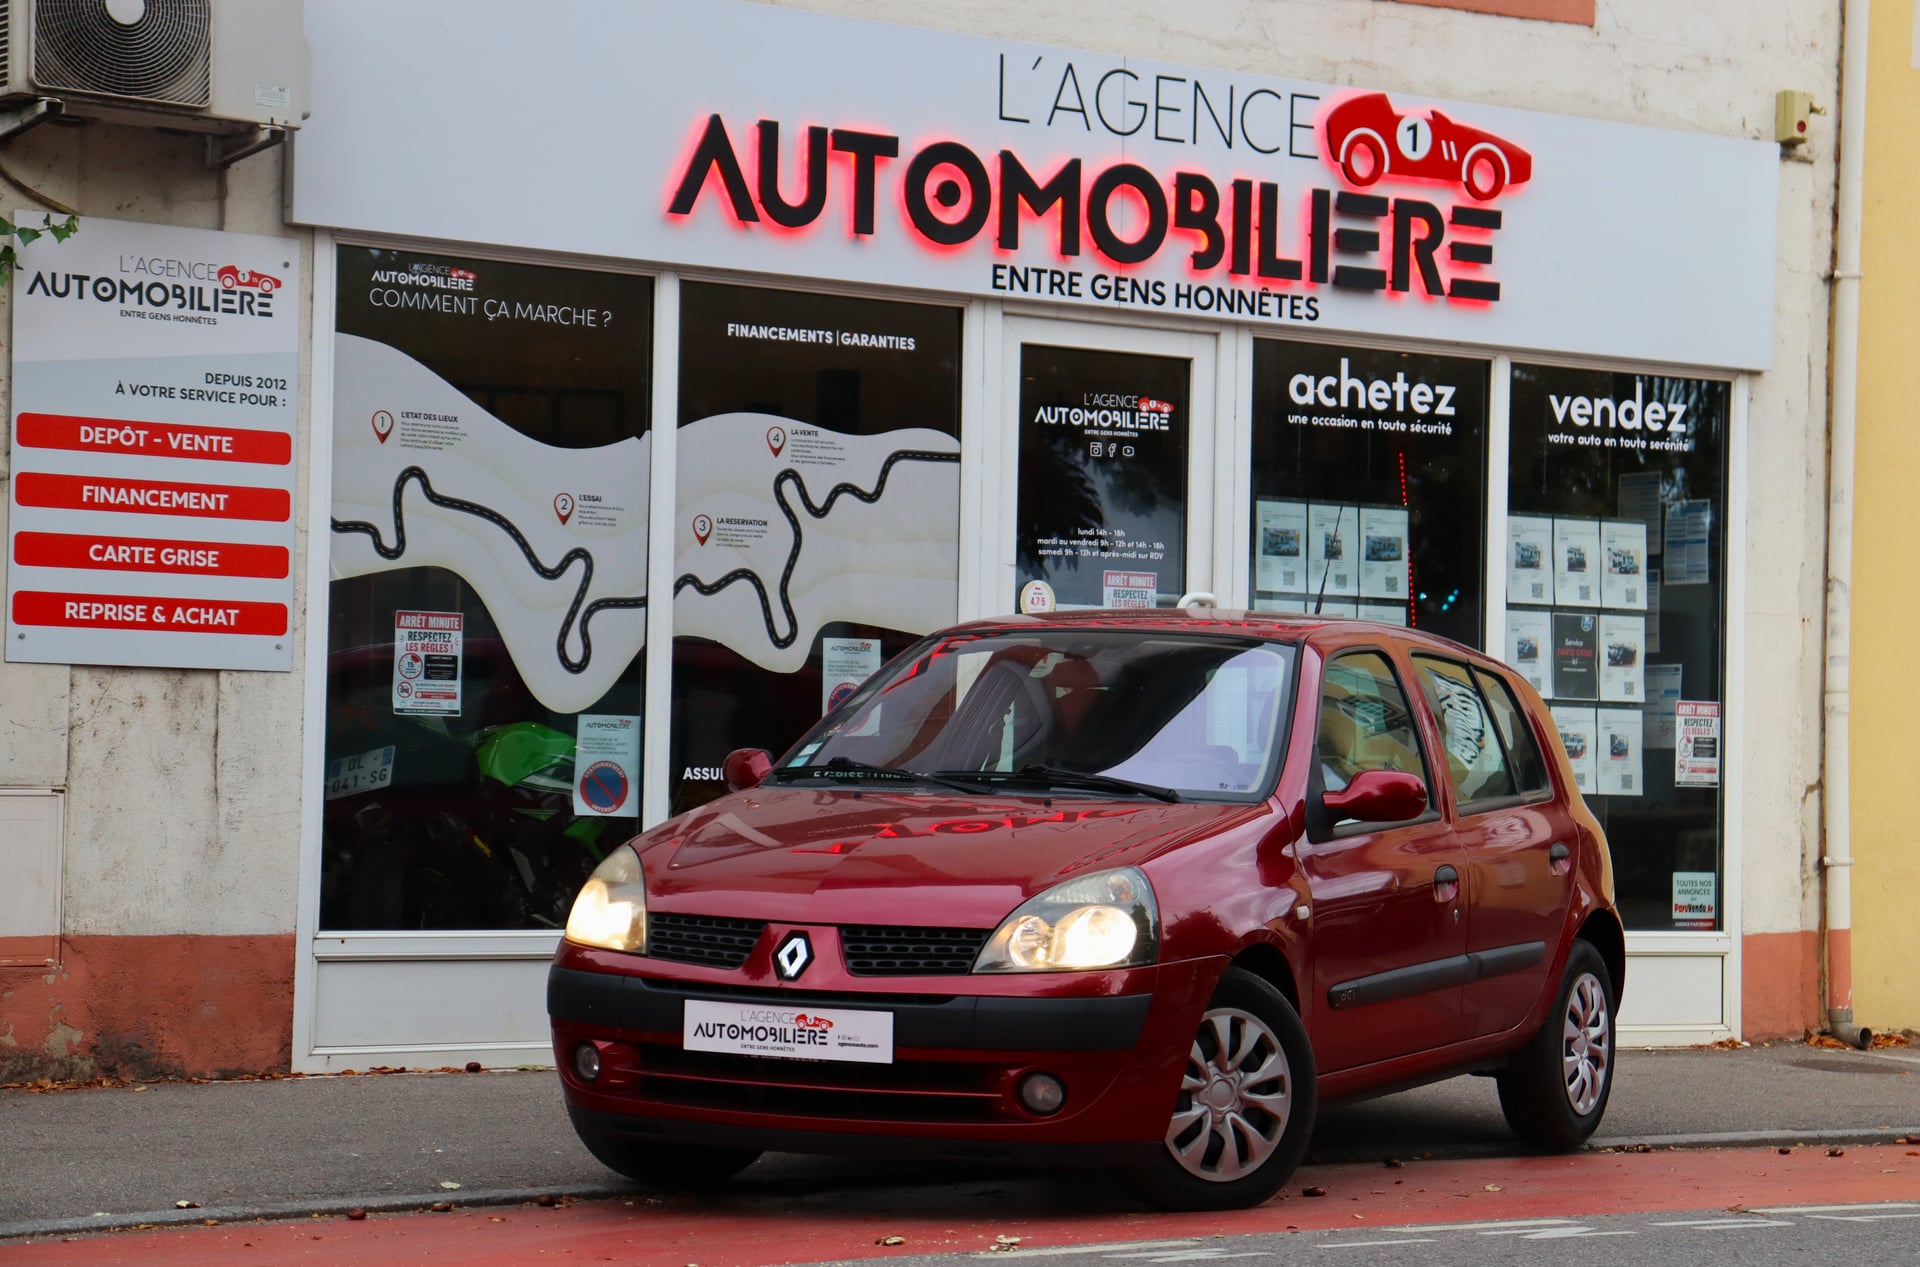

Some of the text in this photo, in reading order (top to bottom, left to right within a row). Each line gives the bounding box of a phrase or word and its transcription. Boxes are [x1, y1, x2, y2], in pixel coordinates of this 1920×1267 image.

[1406, 124, 1421, 151] 1
[991, 262, 1320, 322] ENTRE GENS HONNÊTES
[369, 287, 612, 327] COMMENT ÇA MARCHE ?
[119, 309, 217, 326] ENTRE GENS HONNÊTES
[727, 323, 834, 344] FINANCEMENTS
[840, 332, 916, 351] GARANTIES
[205, 372, 287, 391] DEPUIS 2012
[1288, 357, 1457, 416] achetez
[115, 380, 125, 395] À
[129, 383, 176, 399] VOTRE
[180, 387, 236, 404] SERVICE
[239, 392, 277, 408] POUR
[1549, 381, 1688, 433] vendez
[423, 413, 437, 421] DES
[438, 414, 458, 423] LIEUX
[1288, 414, 1453, 436] une occasion en toute sécurité
[79, 423, 148, 448] DEPÔT
[167, 431, 234, 454] VENTE
[773, 433, 780, 443] 4
[791, 428, 819, 438] LA VENTE
[1084, 428, 1100, 436] ENTRE
[1100, 429, 1113, 437] GENS
[1548, 433, 1575, 445] votre
[1577, 434, 1601, 446] auto
[1604, 437, 1617, 447] en
[1619, 436, 1647, 449] toute
[82, 485, 229, 512] FINANCEMENT
[560, 498, 568, 510] 2
[699, 520, 706, 531] 3
[725, 518, 768, 527] RESERVATION
[1077, 527, 1095, 536] lundi
[1096, 528, 1108, 537] 14h
[1113, 529, 1126, 537] 18h
[1037, 537, 1058, 545] mardi
[1069, 538, 1099, 547] vendredi
[1100, 539, 1109, 547] 9h
[1115, 540, 1126, 548] 12h
[1135, 541, 1147, 549] 14h
[1153, 542, 1165, 550] 18h
[88, 543, 219, 568] CARTE GRISE
[1038, 548, 1063, 556] samedi
[1064, 548, 1074, 556] 9h
[1079, 549, 1091, 557] 12h
[1100, 550, 1137, 559] après-midi
[1149, 552, 1164, 560] RDV
[1113, 589, 1148, 600] RESPECTEZ
[65, 601, 240, 627] REPRISE & ACHAT
[400, 613, 459, 629] ARRÊT MINUTE
[407, 631, 452, 643] RESPECTEZ
[405, 642, 419, 652] LES
[1684, 718, 1713, 728] RESPECTEZ
[1677, 888, 1711, 896] ANNONCES
